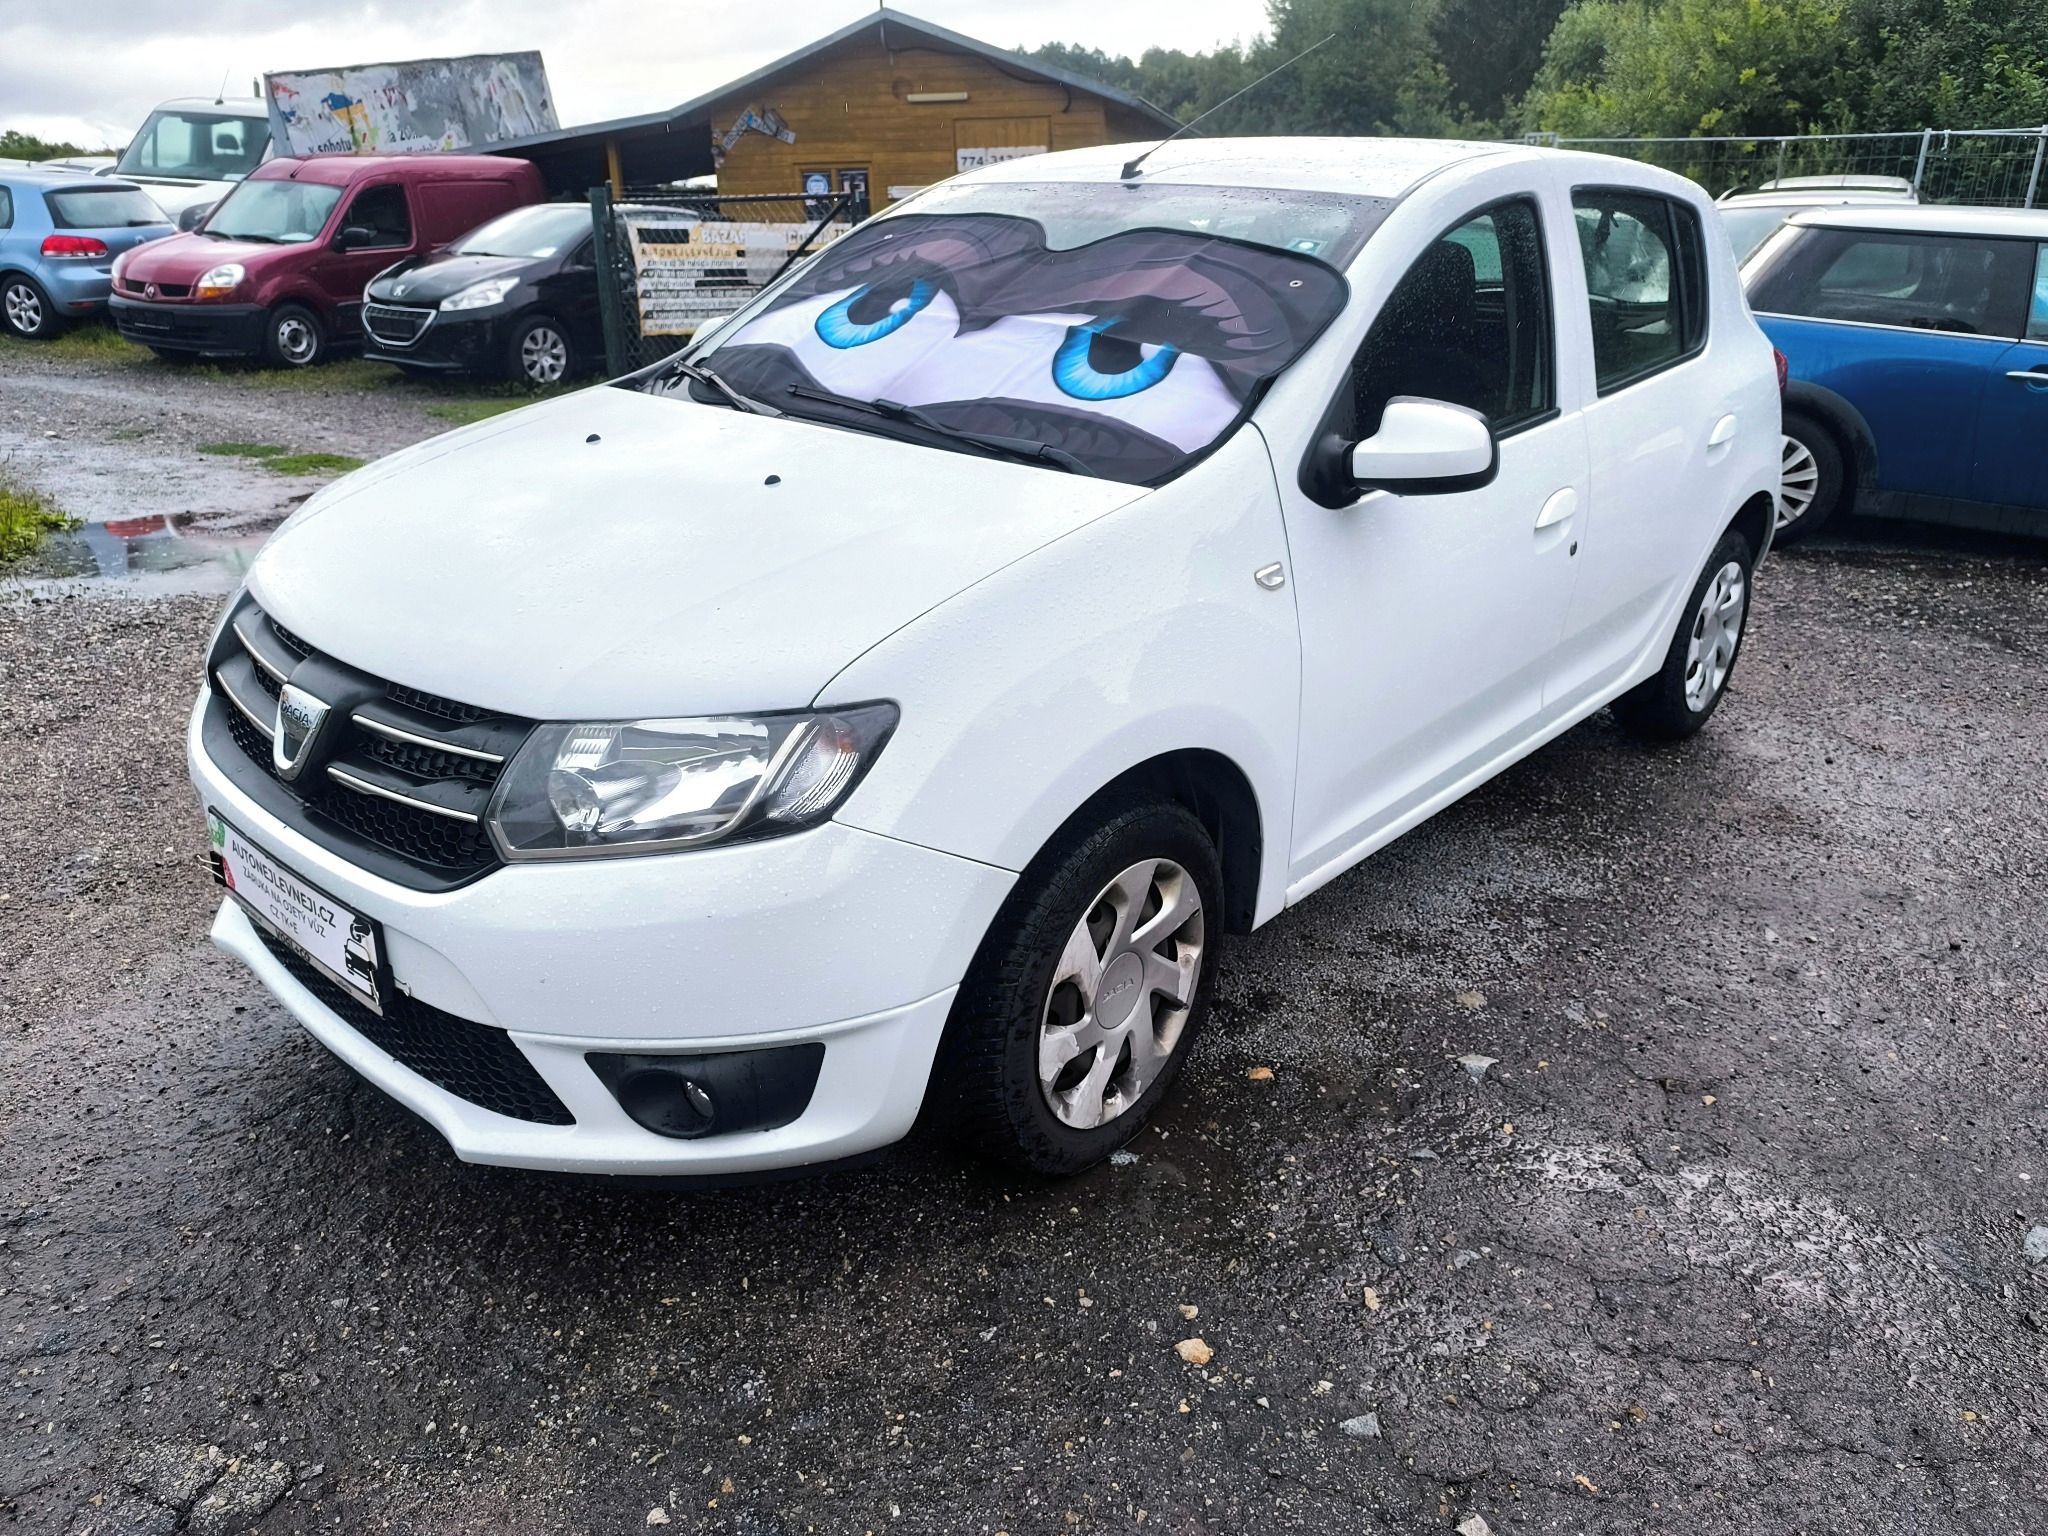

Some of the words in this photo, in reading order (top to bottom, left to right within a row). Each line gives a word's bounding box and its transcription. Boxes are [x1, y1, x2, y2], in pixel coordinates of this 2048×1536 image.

[961, 156, 984, 166] 774
[281, 701, 311, 728] DACIA
[232, 839, 336, 928] AUTONEJLEVNEJI.CZ
